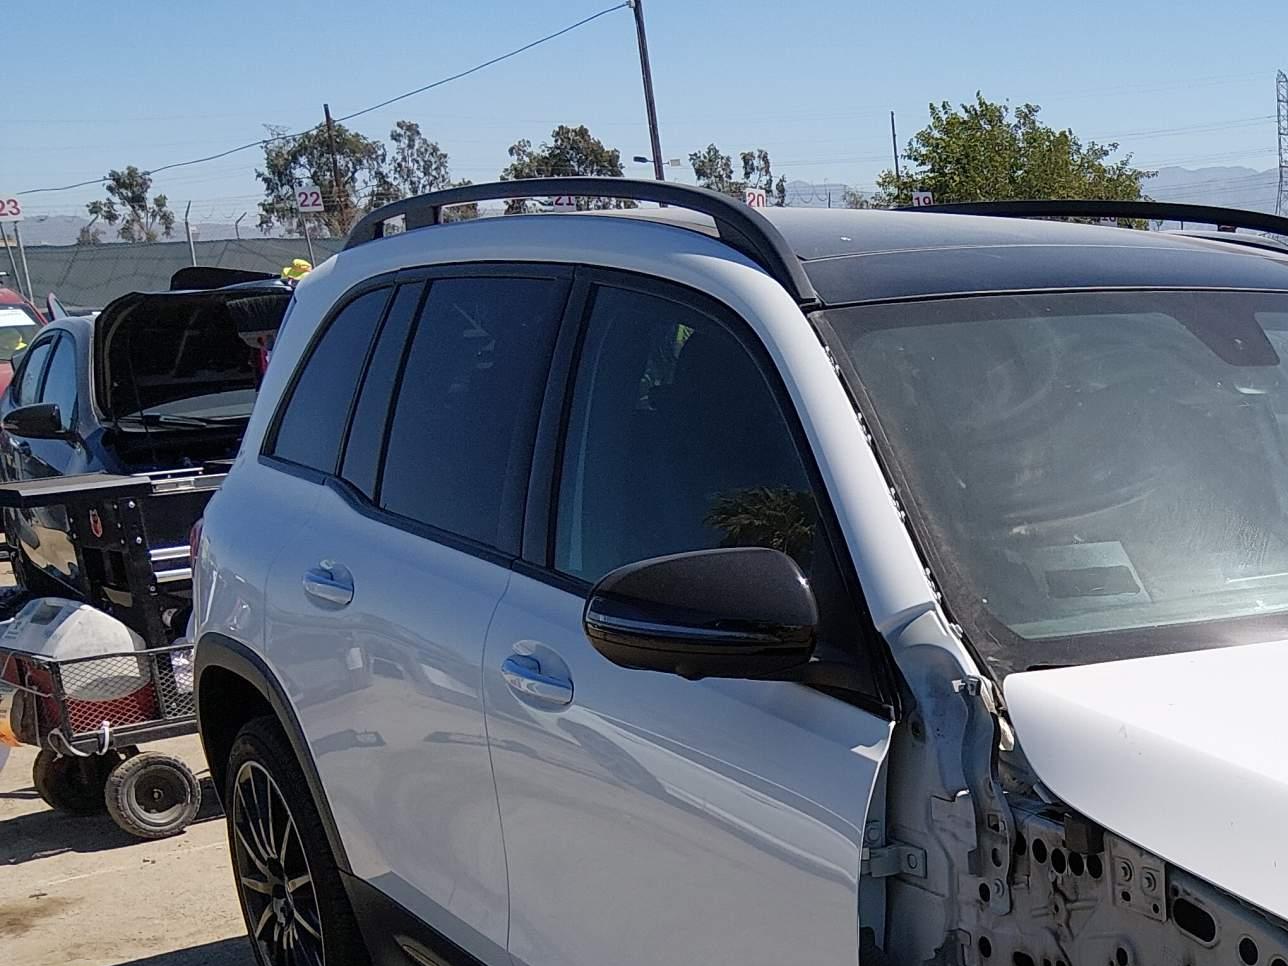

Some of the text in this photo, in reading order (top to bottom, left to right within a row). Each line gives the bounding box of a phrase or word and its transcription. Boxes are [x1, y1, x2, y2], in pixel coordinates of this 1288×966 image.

[298, 191, 322, 207] 22
[747, 192, 765, 207] 20
[0, 199, 21, 216] 23
